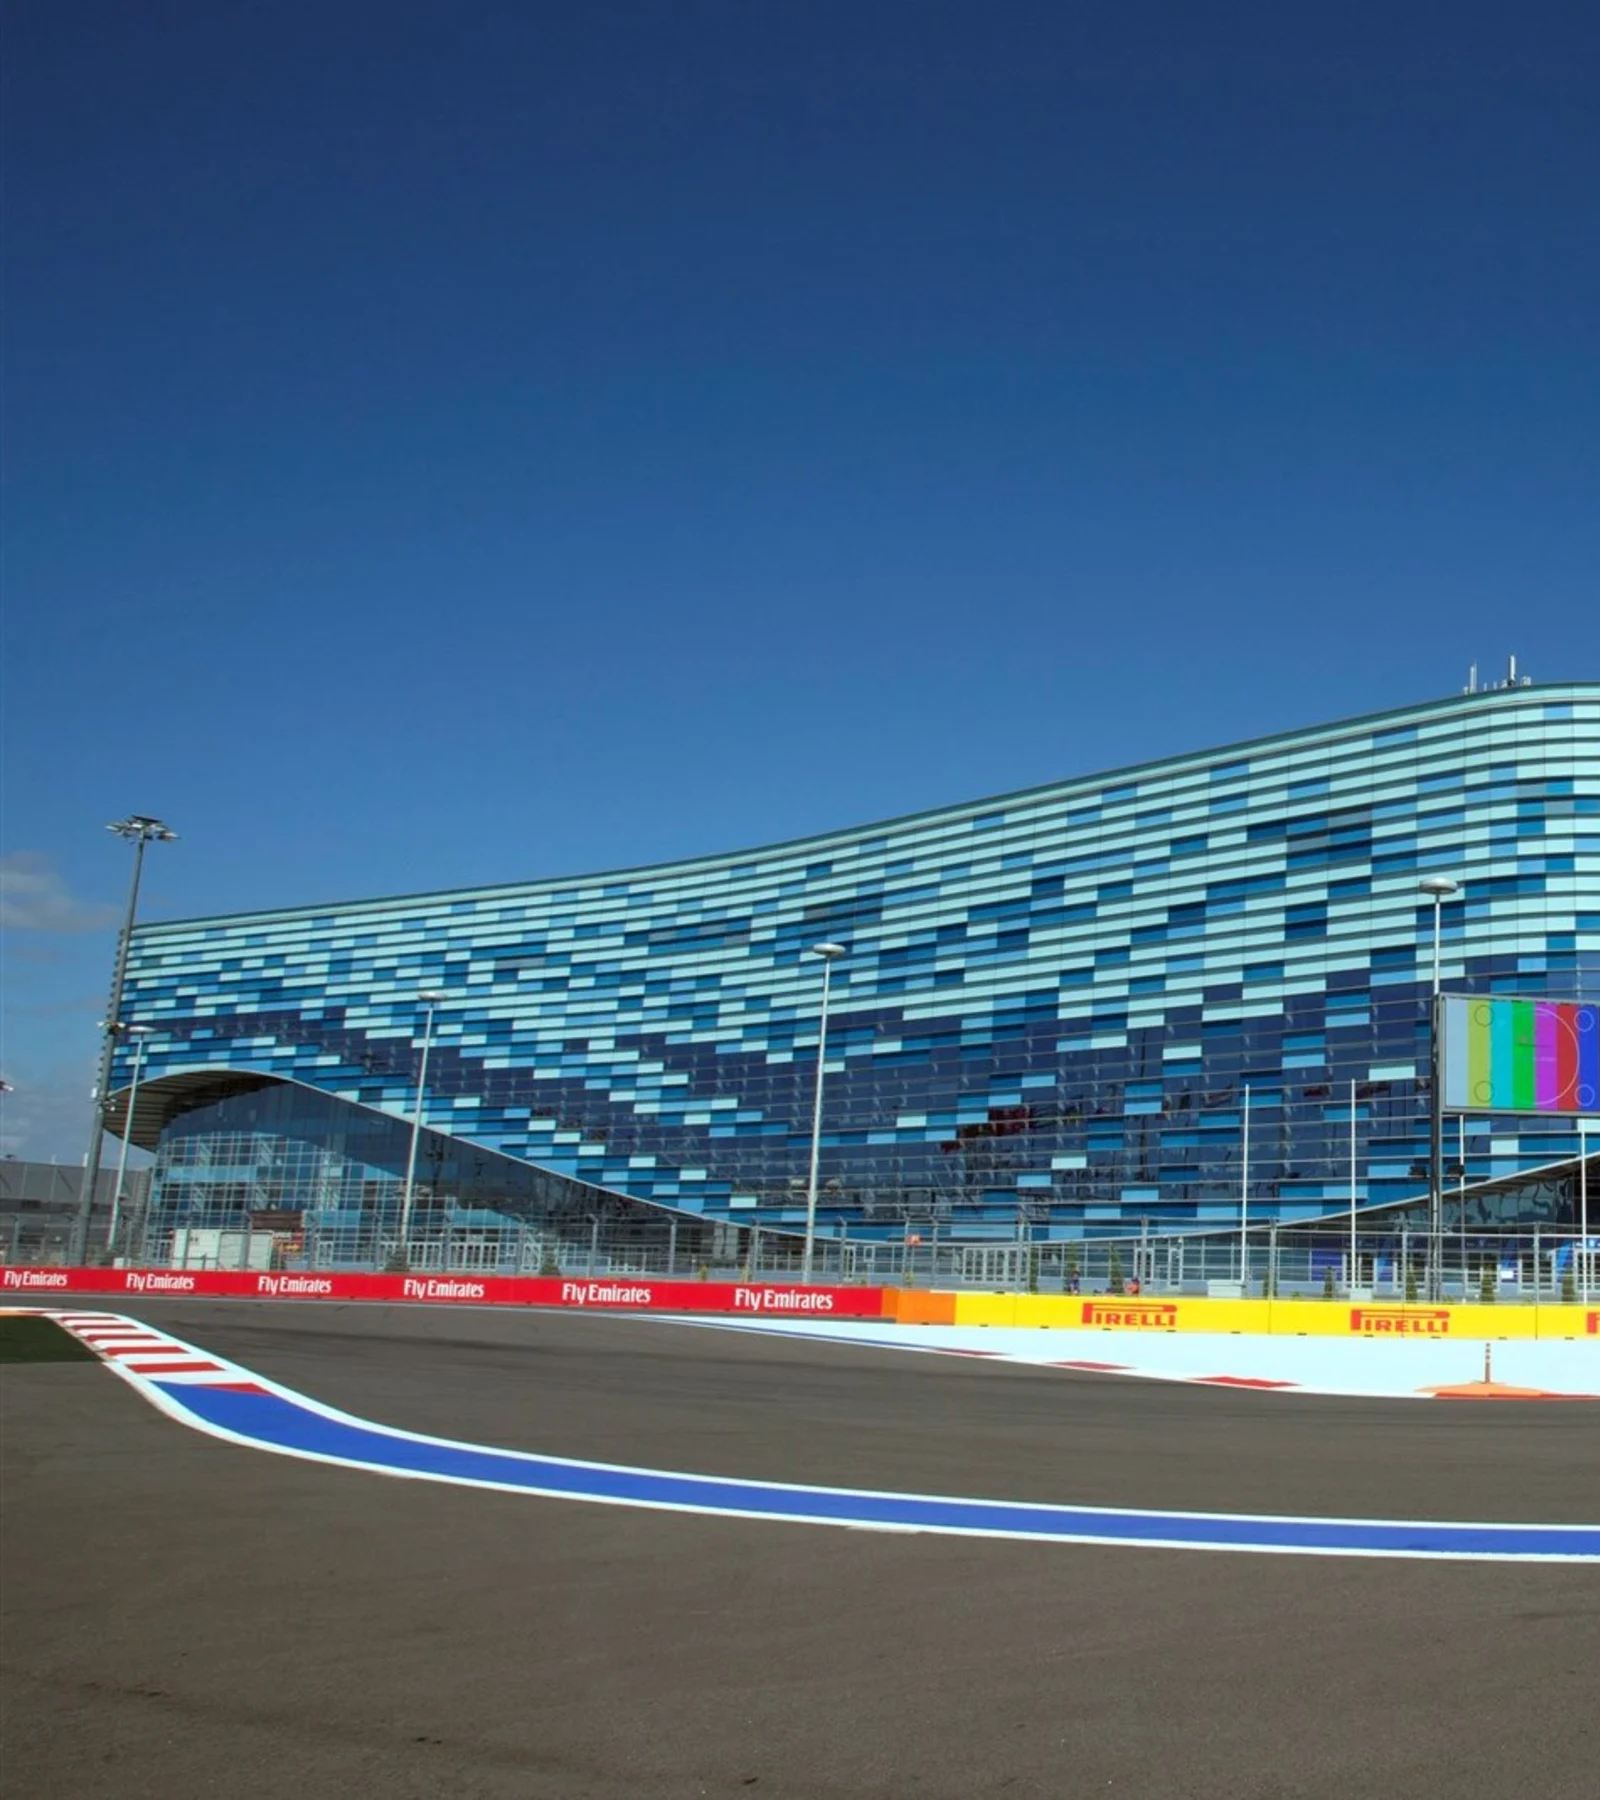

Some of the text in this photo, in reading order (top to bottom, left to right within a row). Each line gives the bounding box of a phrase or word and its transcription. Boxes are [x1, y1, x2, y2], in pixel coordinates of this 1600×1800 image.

[3, 1270, 68, 1288] Fly Emirates
[126, 1272, 194, 1291] Fly Emirates
[258, 1275, 332, 1294] Fly Emirates
[404, 1278, 485, 1299] Fly Emirates
[562, 1283, 652, 1304] Fly Emirates
[735, 1288, 834, 1311] Fly Emirates
[1081, 1302, 1178, 1327] PIRELLI
[1350, 1308, 1450, 1333] PIRELLI
